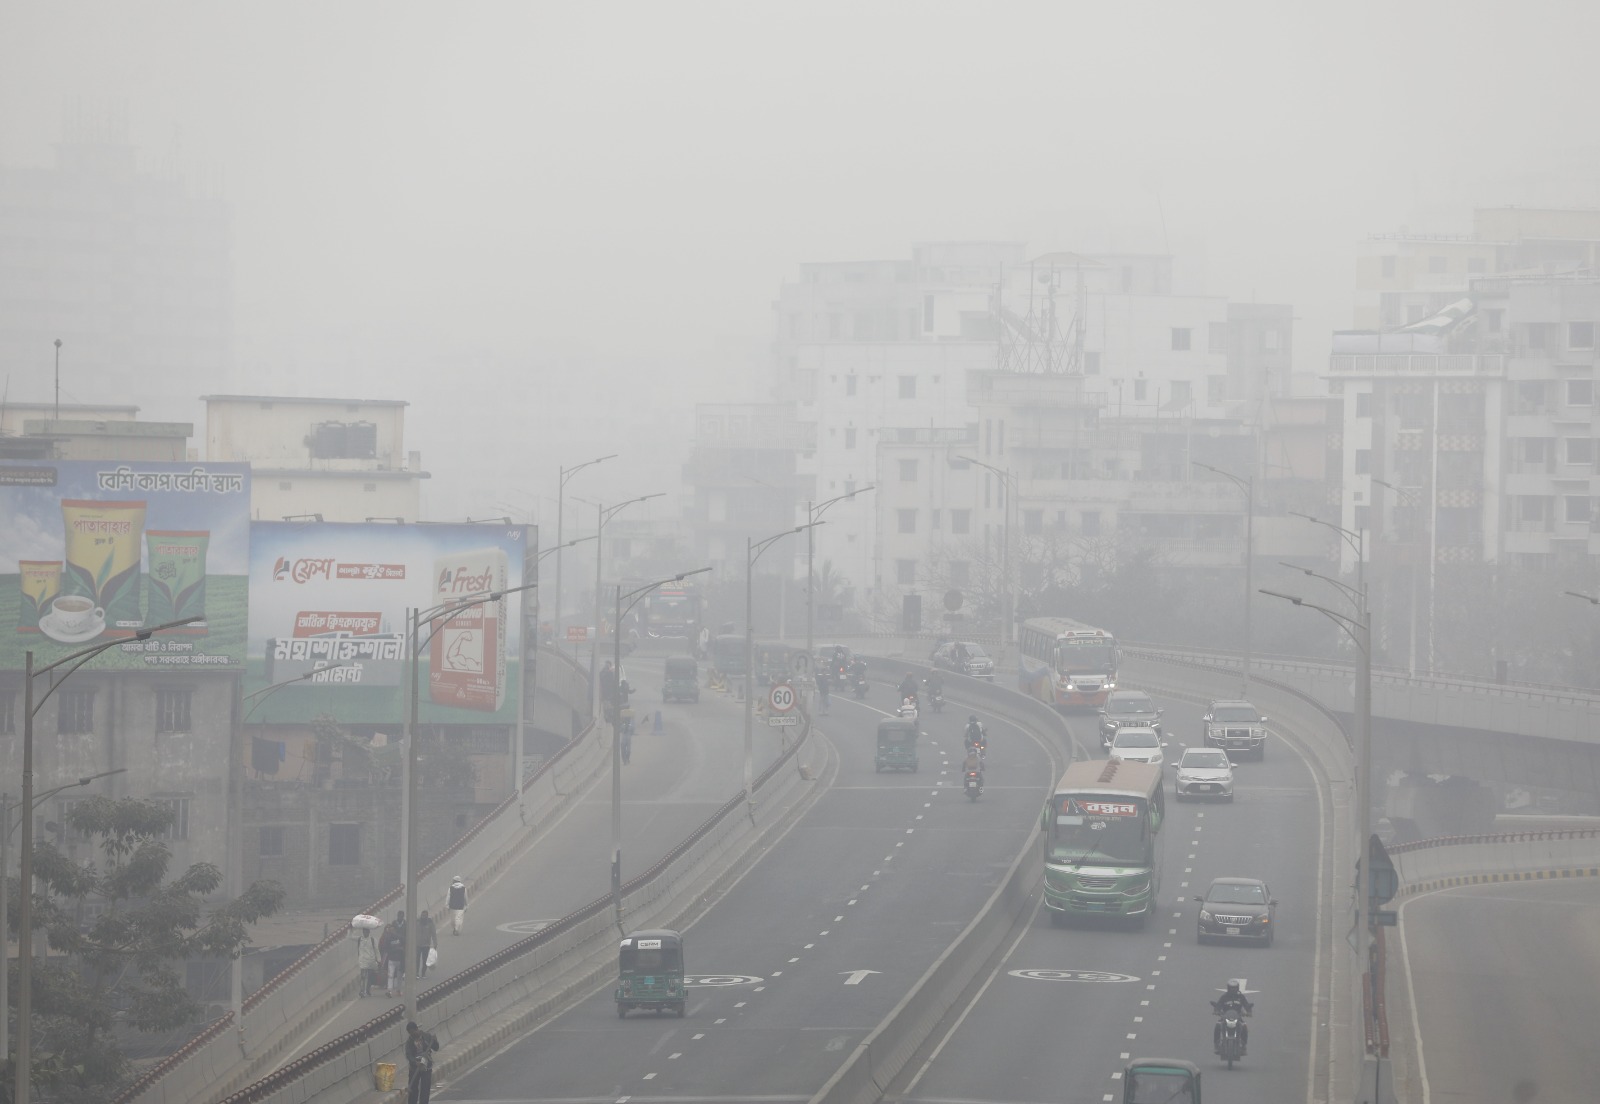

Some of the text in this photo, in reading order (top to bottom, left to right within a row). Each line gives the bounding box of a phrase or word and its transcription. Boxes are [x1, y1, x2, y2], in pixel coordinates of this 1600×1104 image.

[98, 466, 243, 493] বেশি কাপ বেশি স্বাদ
[292, 558, 336, 584] ফ্রেশ
[452, 566, 493, 593] Fresh
[298, 614, 326, 628] অধিক
[274, 631, 406, 661] মহাশক্তিশালী
[312, 660, 364, 683] সিমেন্ট
[773, 690, 791, 704] 60
[1086, 802, 1136, 814] বন্ধন
